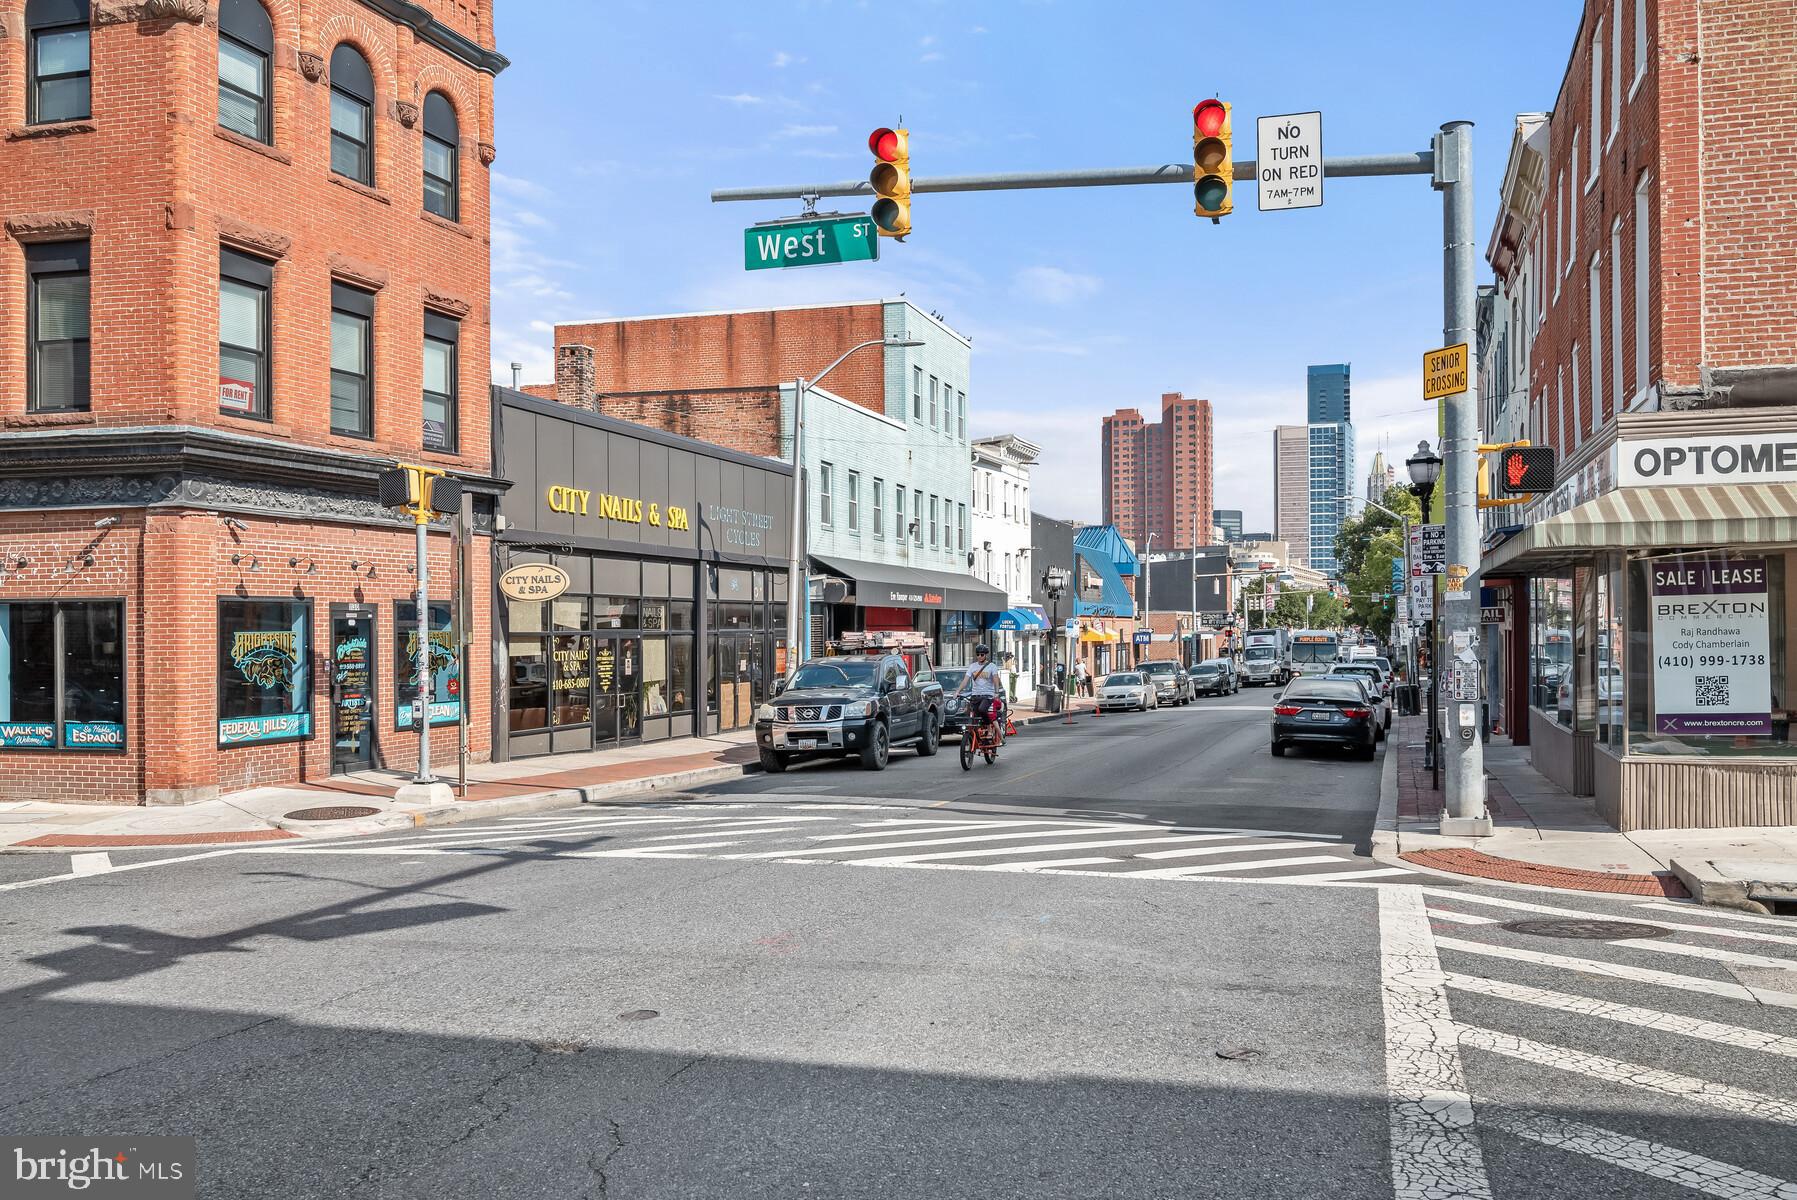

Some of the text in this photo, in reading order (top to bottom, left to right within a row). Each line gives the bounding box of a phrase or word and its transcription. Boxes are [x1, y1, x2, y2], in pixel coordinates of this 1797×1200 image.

[1278, 126, 1300, 140] NO
[1271, 145, 1309, 160] TURN
[1262, 165, 1318, 182] ON RED
[1266, 186, 1314, 199] 7AM-7PM
[757, 222, 870, 260] West ST
[1431, 352, 1460, 373] SENIOR
[1426, 371, 1465, 394] CROSSING
[222, 386, 248, 401] FOR RENT
[547, 485, 690, 531] CITY NAILS & SPA
[710, 504, 774, 530] LIGHT STREET
[726, 529, 761, 547] CYCLES
[1423, 538, 1446, 546] PARKING
[505, 574, 561, 585] CITY NAILS
[1656, 568, 1763, 586] SALE LEASE
[518, 585, 549, 594] & SPA
[643, 607, 662, 618] NAILS
[1481, 609, 1503, 618] AIL
[1657, 600, 1765, 616] BREXTON
[648, 618, 662, 629] SPA
[1680, 627, 1741, 637] Raj Randhawa
[231, 631, 298, 660] BRIGHTSIDE
[1672, 640, 1750, 650] Cody Chamberlain
[553, 650, 588, 661] CITY NAILS
[1658, 655, 1765, 669] (410) 999-1738
[563, 661, 581, 671] & SPA
[0, 725, 54, 739] WALK-INS
[221, 720, 261, 737] FEDERAL
[263, 717, 288, 734] HILLS
